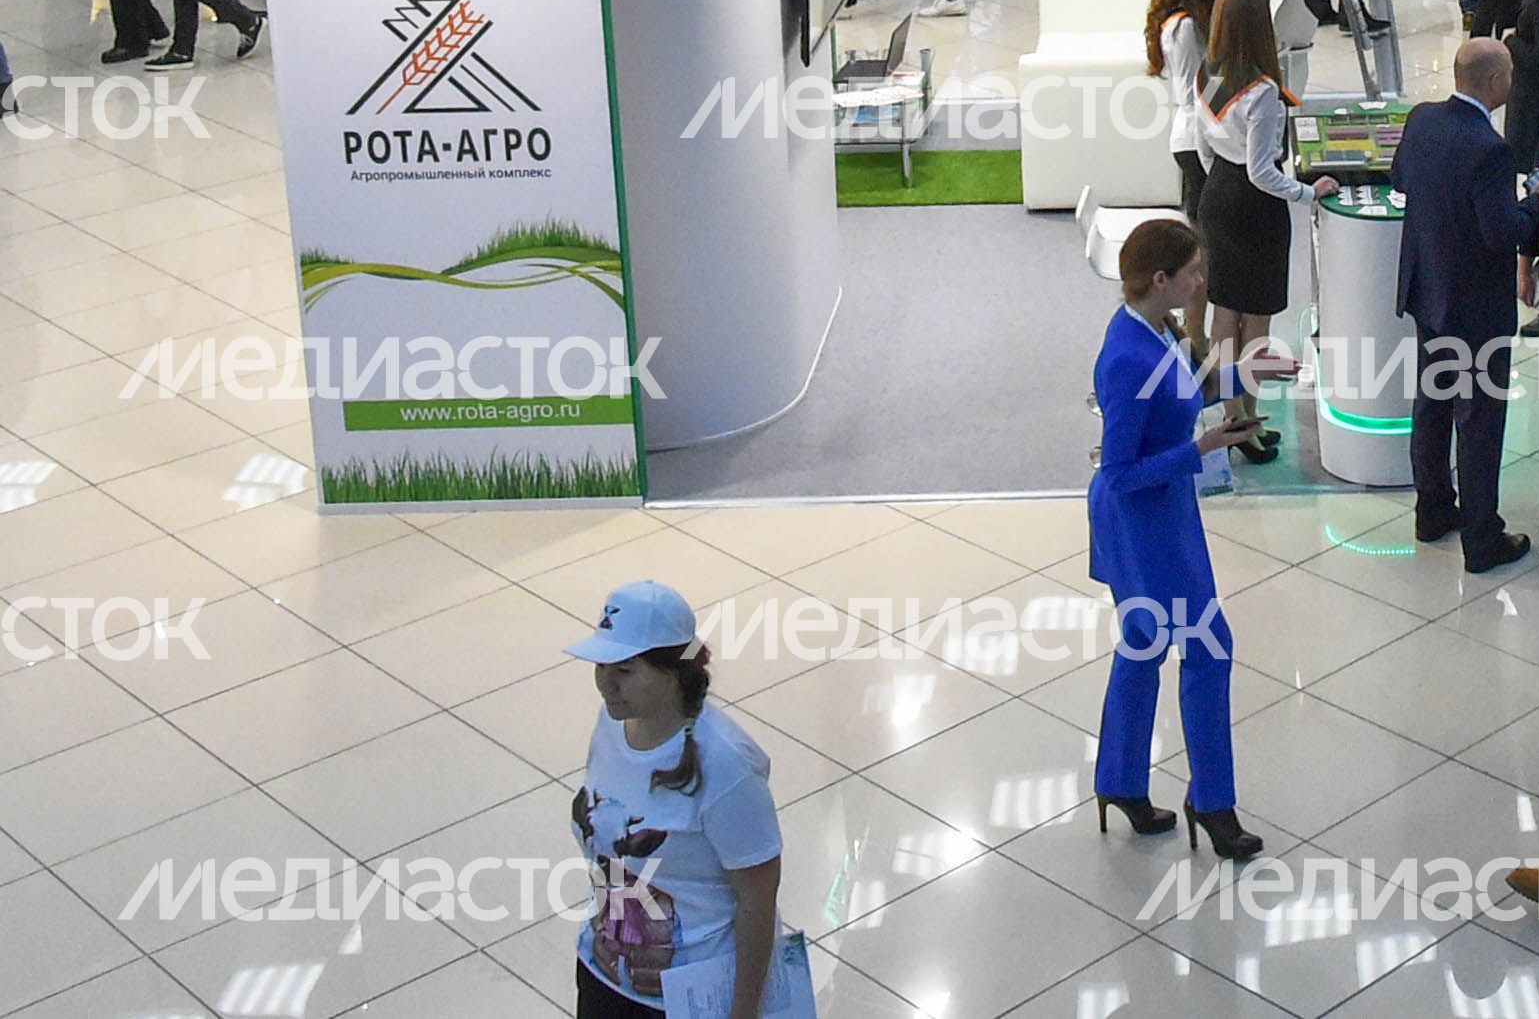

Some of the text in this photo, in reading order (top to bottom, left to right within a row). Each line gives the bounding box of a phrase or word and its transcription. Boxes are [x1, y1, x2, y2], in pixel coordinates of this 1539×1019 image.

[343, 127, 552, 164] РОТА-АГРО
[351, 168, 552, 182] Агропромышленный комплекс
[400, 403, 581, 422] www.rota-agro.ru
